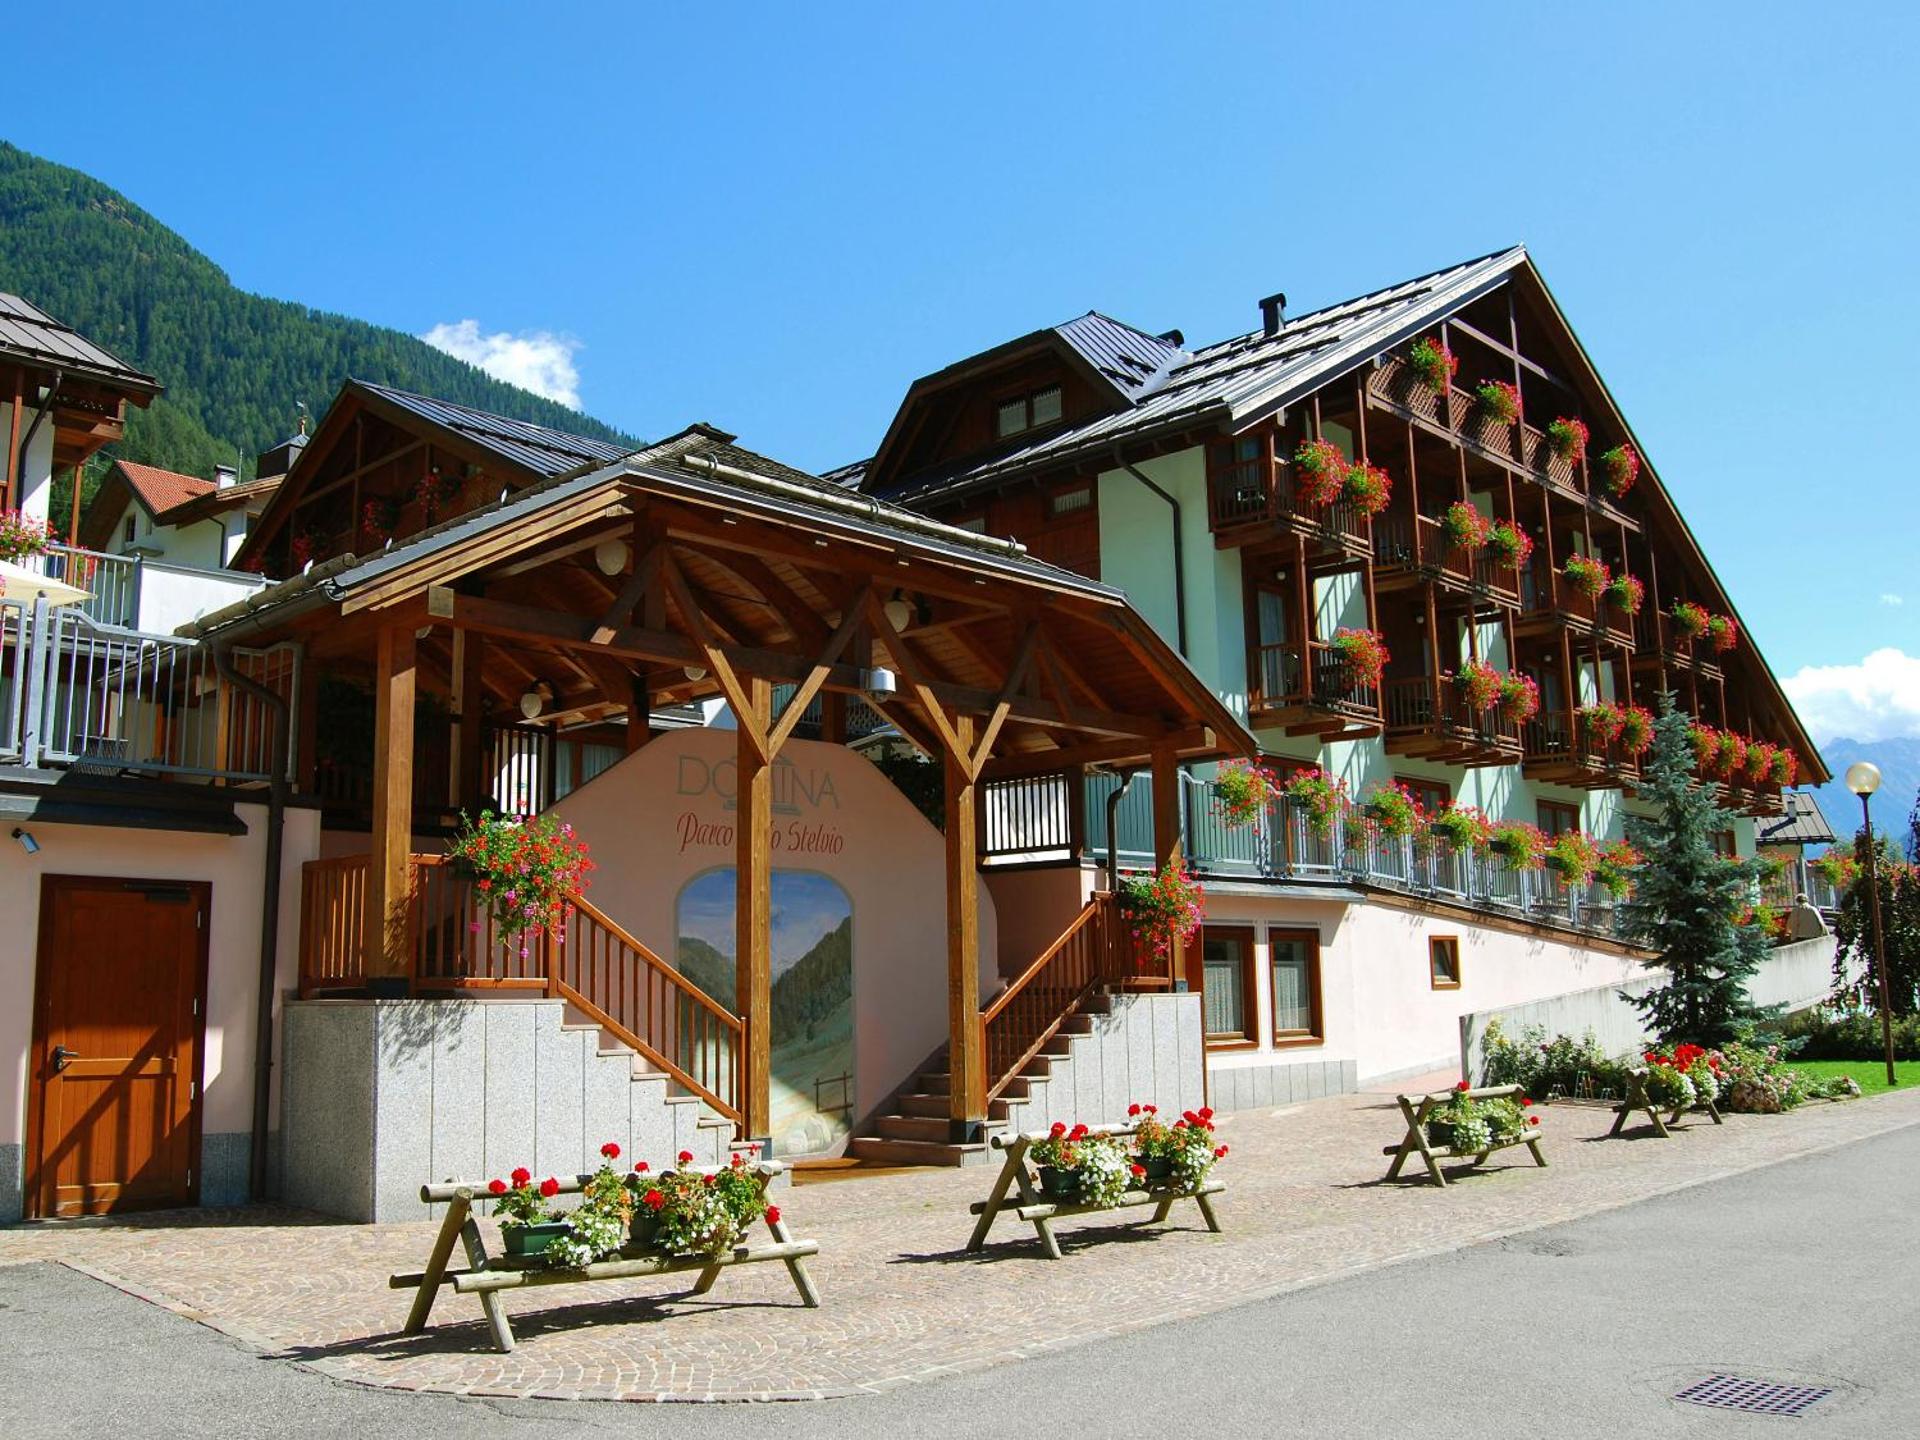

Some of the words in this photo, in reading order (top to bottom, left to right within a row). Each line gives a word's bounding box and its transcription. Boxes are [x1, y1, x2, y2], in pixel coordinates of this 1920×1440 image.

[676, 755, 841, 810] DOINA
[676, 811, 734, 856] Parco
[787, 820, 844, 855] Stelvio
